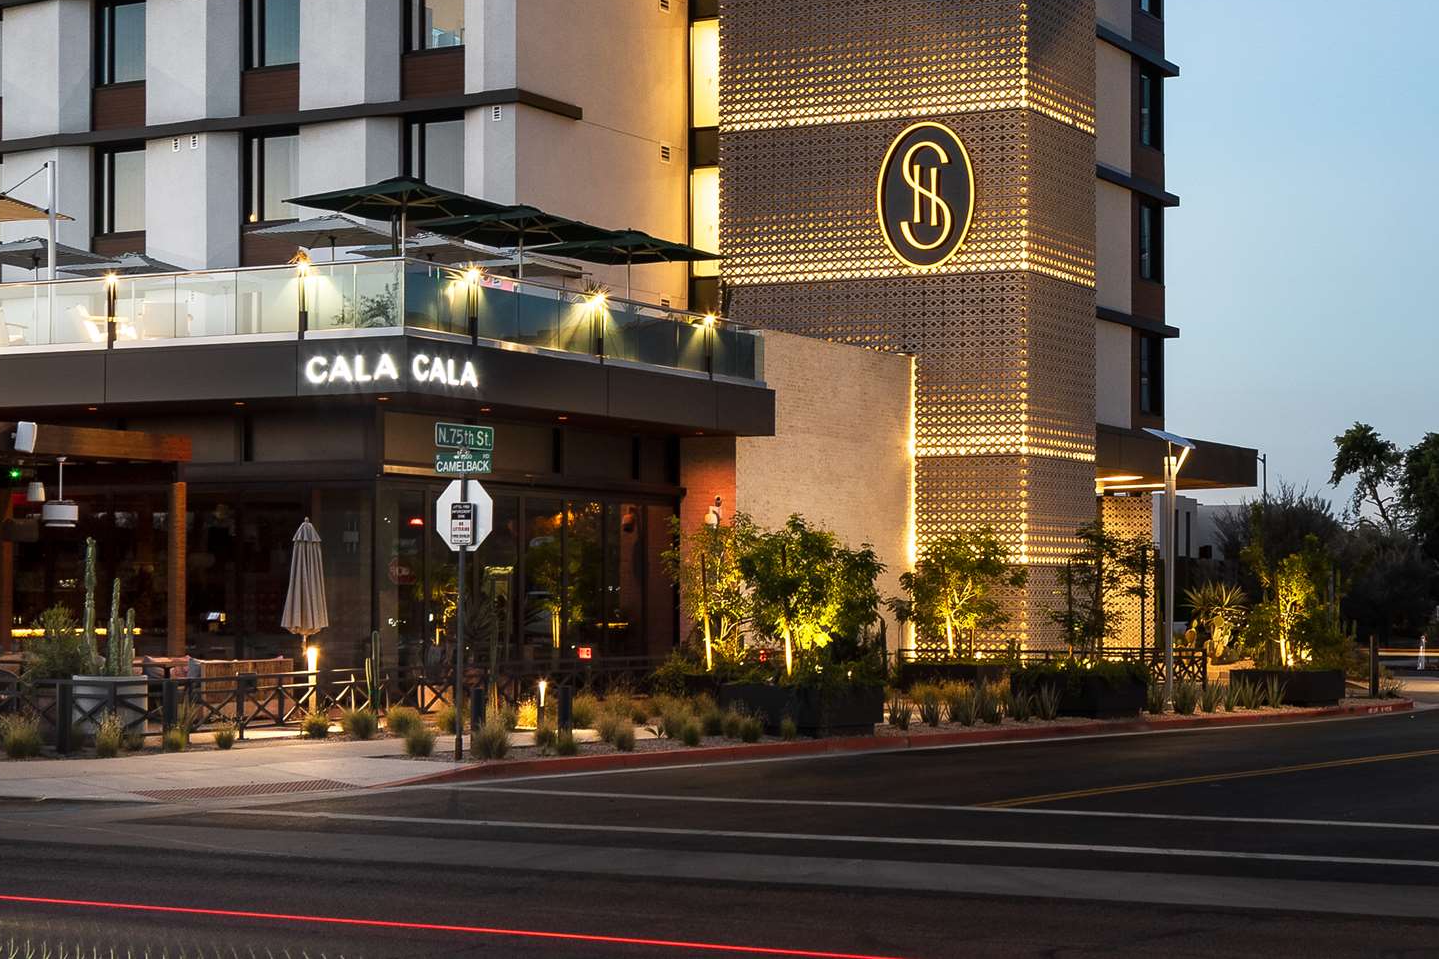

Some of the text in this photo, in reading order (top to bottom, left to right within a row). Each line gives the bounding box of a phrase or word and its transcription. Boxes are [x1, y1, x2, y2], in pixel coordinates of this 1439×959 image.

[306, 354, 479, 387] CALA CALA
[436, 460, 489, 472] CAMELBACK
